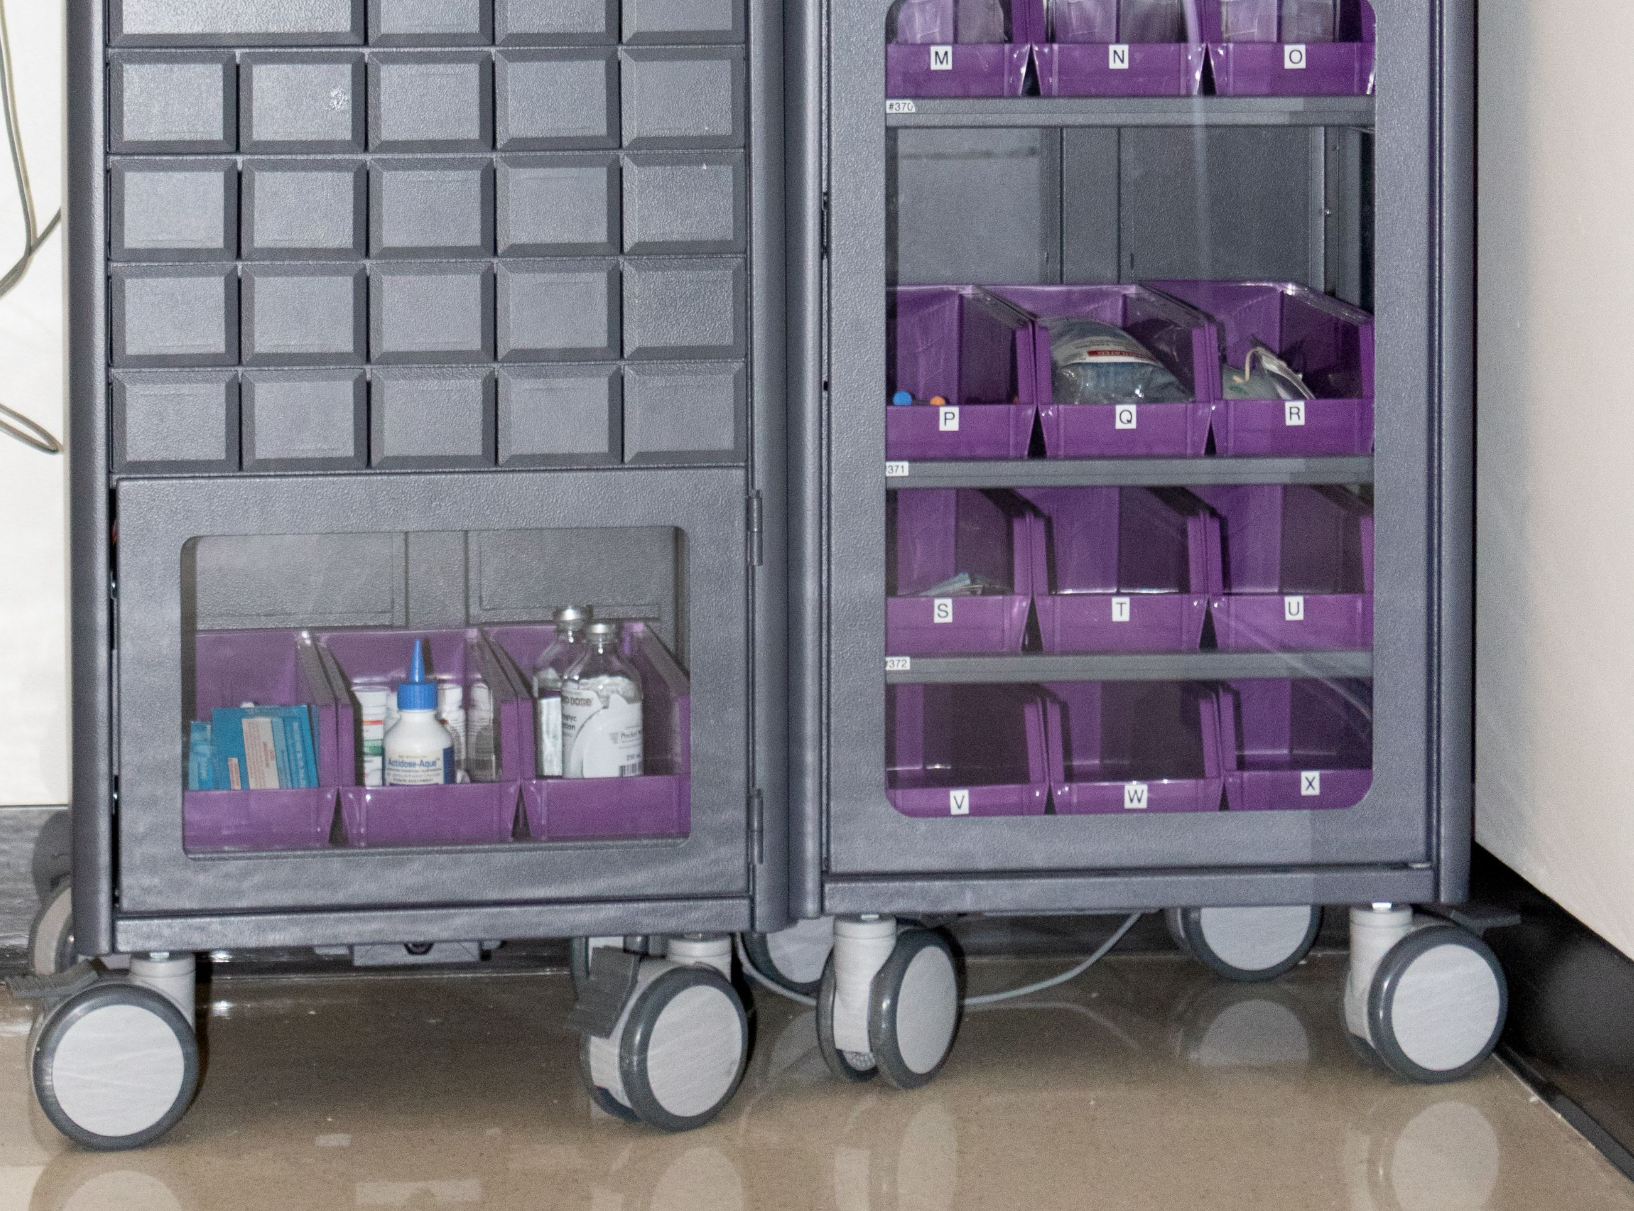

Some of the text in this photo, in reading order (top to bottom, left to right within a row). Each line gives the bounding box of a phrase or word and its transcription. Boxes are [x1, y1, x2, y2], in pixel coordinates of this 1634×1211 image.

[934, 50, 949, 65] M
[1113, 49, 1125, 64] N
[1288, 49, 1303, 65] O
[889, 102, 913, 112] #370
[944, 411, 956, 426] P
[1118, 409, 1133, 425] Q
[1289, 406, 1301, 421] R
[887, 465, 905, 475] 371
[937, 603, 949, 619] S
[1118, 602, 1126, 617] T
[1288, 601, 1300, 616] U
[1305, 776, 1316, 791] X
[953, 795, 965, 810] V
[1127, 789, 1144, 804] W
